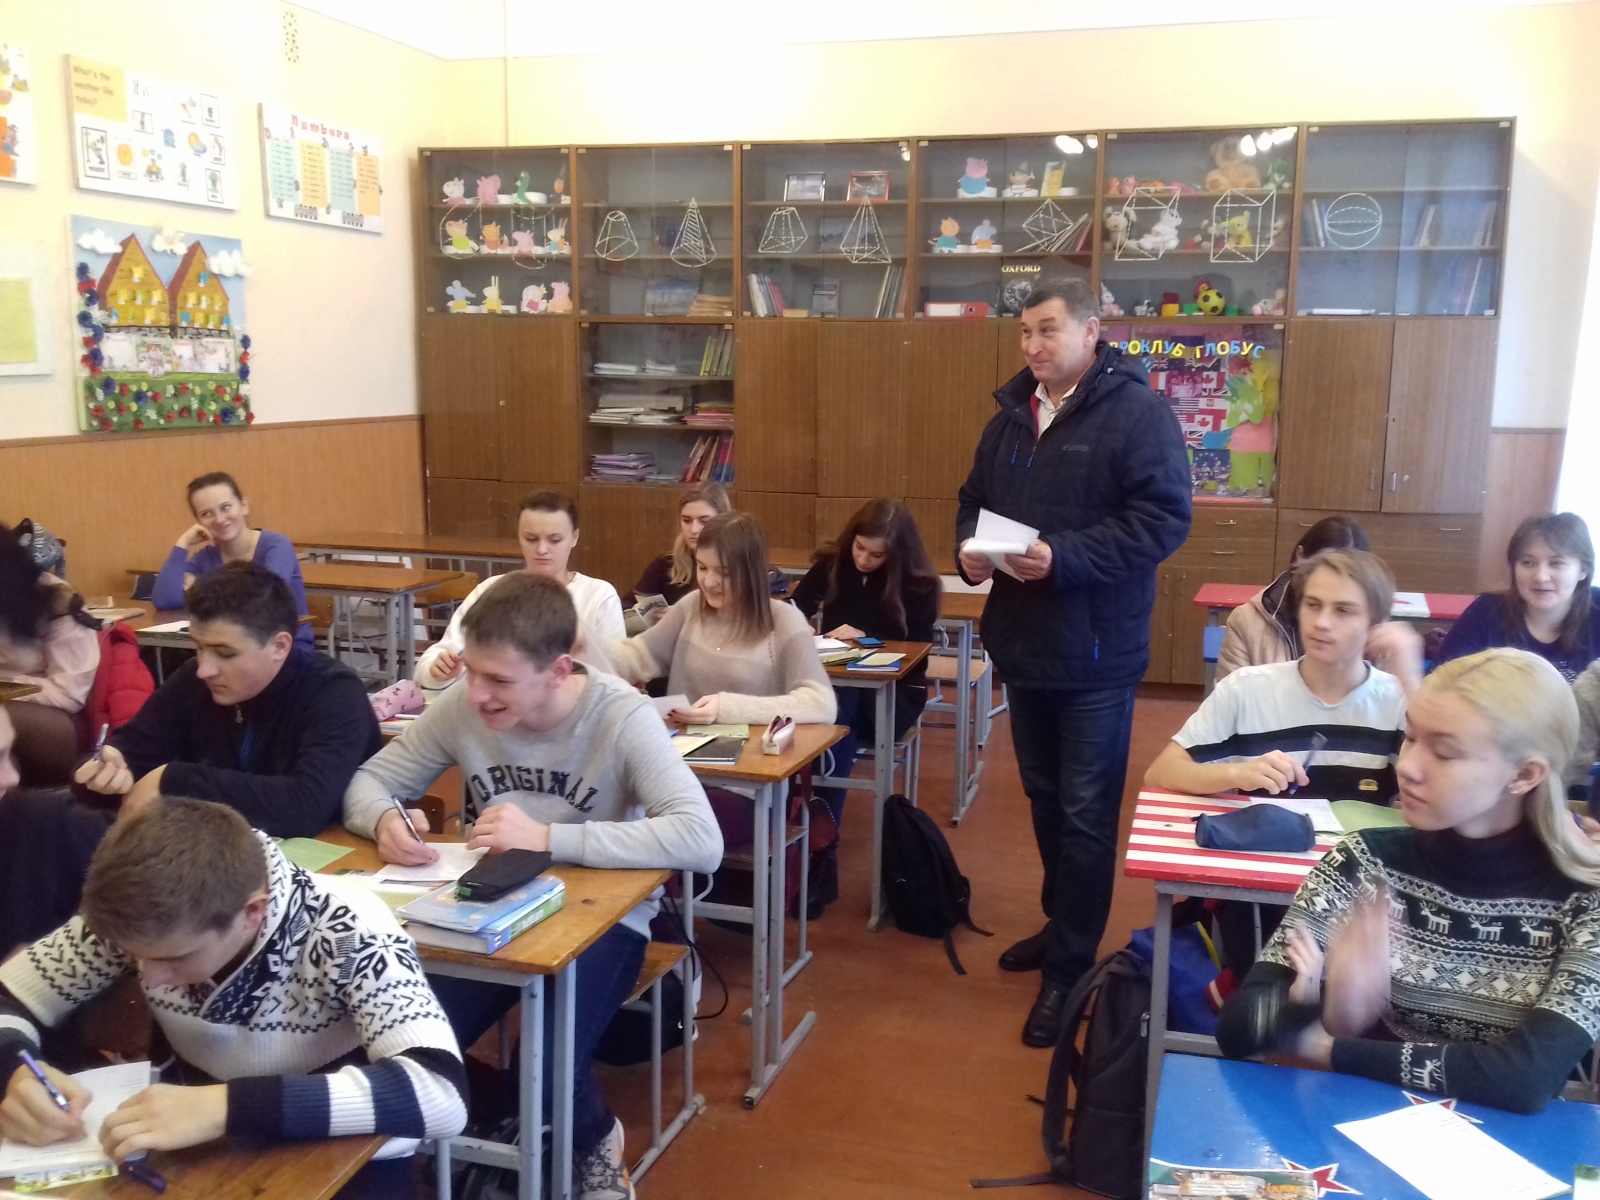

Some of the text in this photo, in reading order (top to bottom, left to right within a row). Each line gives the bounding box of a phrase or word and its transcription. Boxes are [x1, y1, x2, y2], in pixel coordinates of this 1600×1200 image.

[291, 113, 350, 141] Numbers
[1001, 264, 1041, 273] OXFORD
[1195, 340, 1265, 359] ГЛОБУС
[471, 764, 599, 814] ORIGINAL
